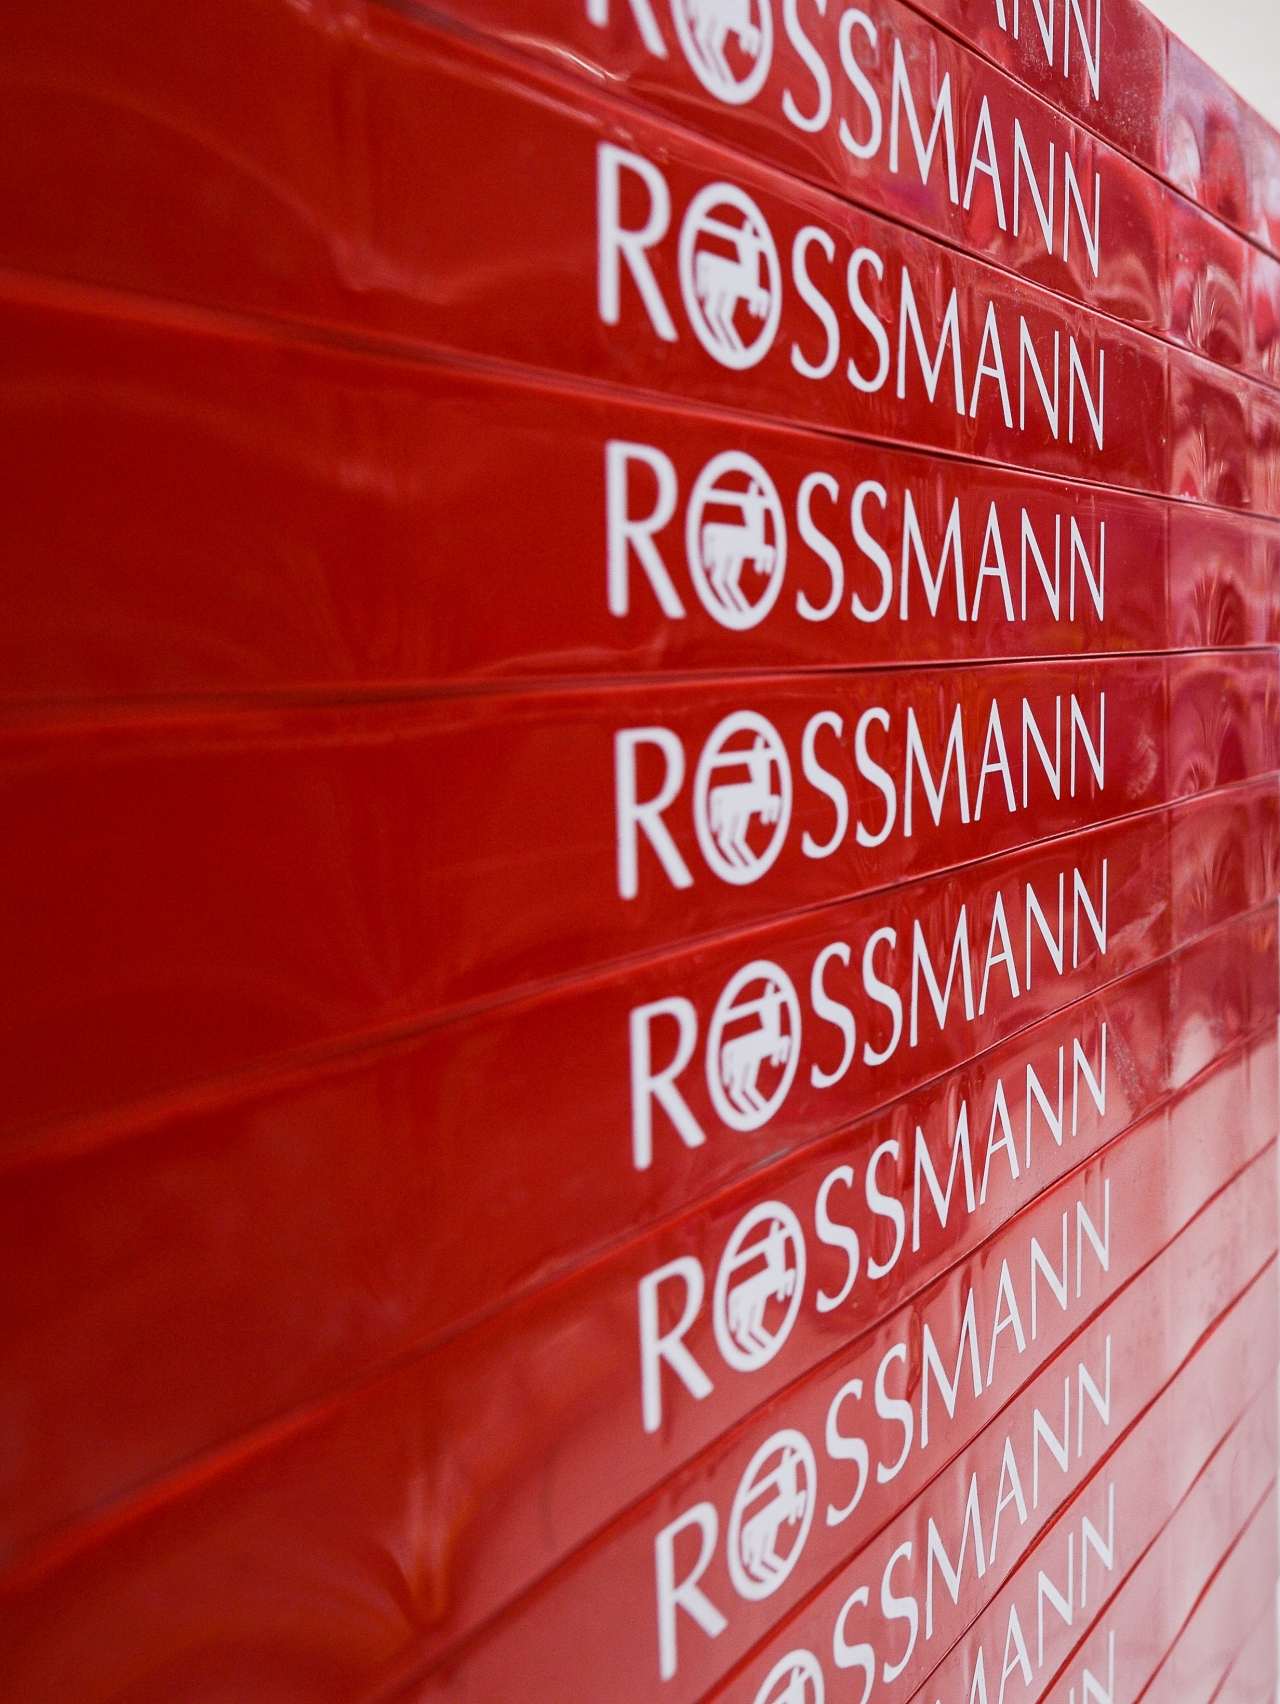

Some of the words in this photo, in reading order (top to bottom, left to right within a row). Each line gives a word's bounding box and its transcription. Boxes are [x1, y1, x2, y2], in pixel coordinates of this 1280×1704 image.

[587, 0, 1101, 278] OSSMANN
[598, 144, 1105, 451] ROSSMANN
[607, 442, 1105, 630] ROSSMANN
[616, 692, 1105, 898] ROSSMANN
[631, 858, 1107, 1169] ROSSMANN
[639, 1022, 1107, 1432] ROSSMANN
[655, 1177, 1110, 1680] ROSSMANN
